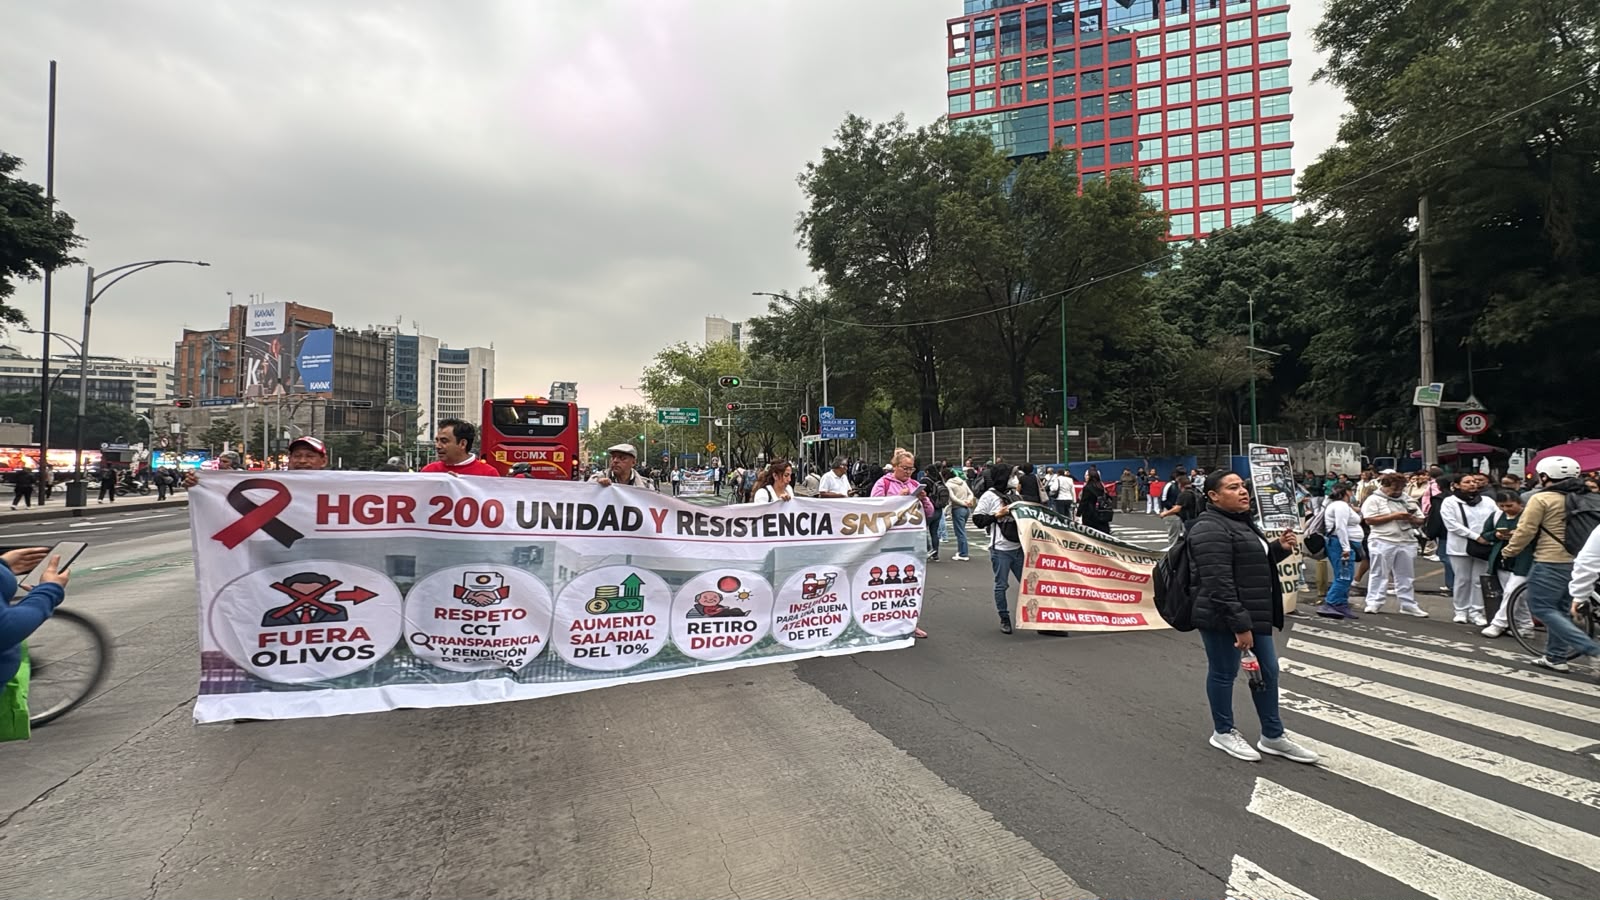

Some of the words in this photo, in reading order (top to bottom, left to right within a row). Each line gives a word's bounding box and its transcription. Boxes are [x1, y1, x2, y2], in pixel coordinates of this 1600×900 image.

[1465, 416, 1481, 426] 30
[514, 451, 547, 460] CDMX
[316, 494, 416, 526] HGR
[428, 494, 505, 528] 200
[516, 499, 643, 532] UNIDAD
[650, 508, 668, 534] Y
[677, 510, 833, 537] RESISTENCIA
[1042, 558, 1056, 567] POR
[1058, 560, 1068, 569] LA
[1110, 571, 1126, 579] DEL
[1040, 584, 1058, 594] POR
[872, 601, 887, 611] DE
[891, 597, 916, 608] MÁS
[434, 607, 527, 622] RESPETO
[776, 614, 798, 624] PARA
[817, 603, 848, 614] BUENA
[1042, 612, 1062, 620] POR
[1064, 612, 1077, 621] UN
[1078, 614, 1110, 624] RETIRO
[1112, 616, 1138, 625] DIGNO
[570, 614, 656, 632] AUMENTO
[686, 620, 758, 634] RETIRO
[780, 612, 842, 632] ATENCIÓN
[258, 626, 370, 648] FUERA
[460, 624, 500, 636] CCT
[570, 630, 654, 645] SALARIAL
[788, 631, 804, 641] DE
[808, 628, 832, 639] PTE.
[430, 635, 540, 648] TRANSPARENCIA
[690, 634, 754, 650] DIGNO
[251, 644, 376, 668] OLIVOS
[440, 647, 449, 655] Y
[453, 647, 527, 658] RENDICIÓN
[574, 646, 610, 659] DEL
[616, 644, 650, 656] 10%
